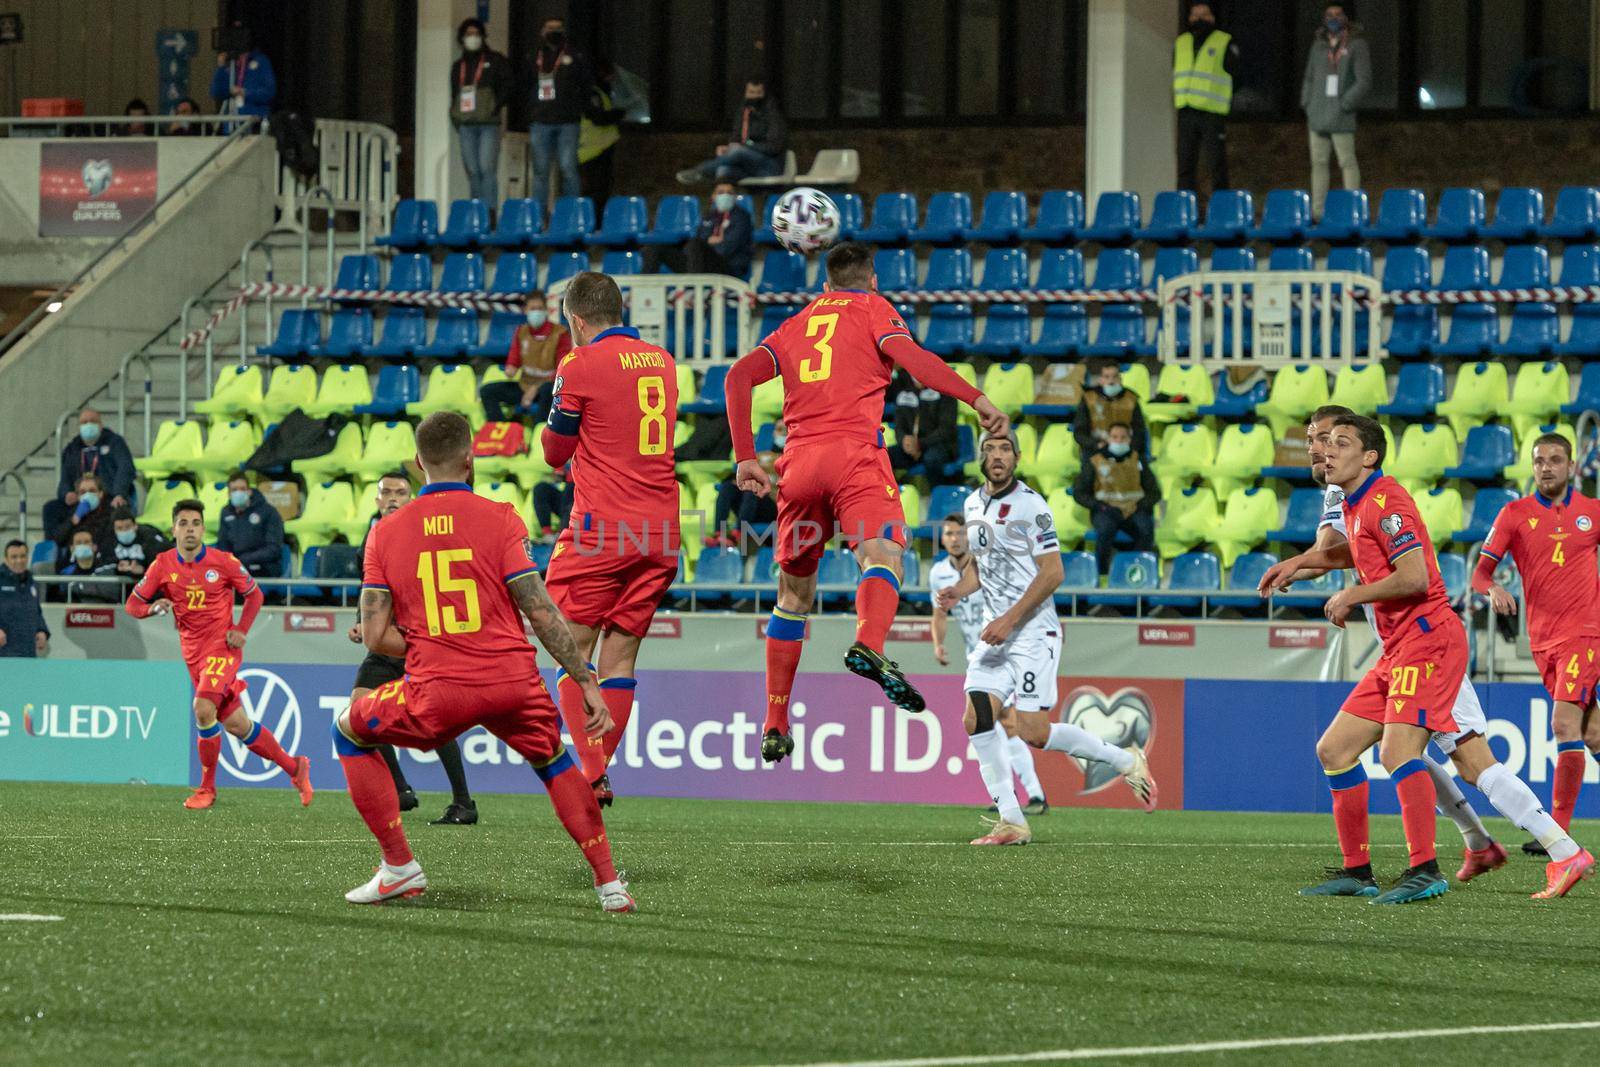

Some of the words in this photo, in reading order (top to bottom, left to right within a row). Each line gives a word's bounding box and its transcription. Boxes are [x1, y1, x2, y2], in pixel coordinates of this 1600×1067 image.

[72, 210, 122, 221] QUALIFIERS
[800, 312, 839, 383] 3
[618, 352, 665, 370] MARCIO
[637, 376, 667, 456] 8
[423, 514, 454, 537] MOI
[978, 525, 988, 548] 8
[1551, 541, 1565, 567] 4
[185, 590, 206, 610] 22
[416, 548, 482, 636] 15
[70, 612, 111, 624] UEFA.com
[1143, 629, 1190, 641] UEFA.com
[206, 656, 227, 676] 22
[1566, 653, 1580, 679] 4
[1022, 670, 1036, 694] 8
[1388, 666, 1419, 697] 20
[769, 694, 789, 705] FAF
[870, 705, 981, 775] ID.
